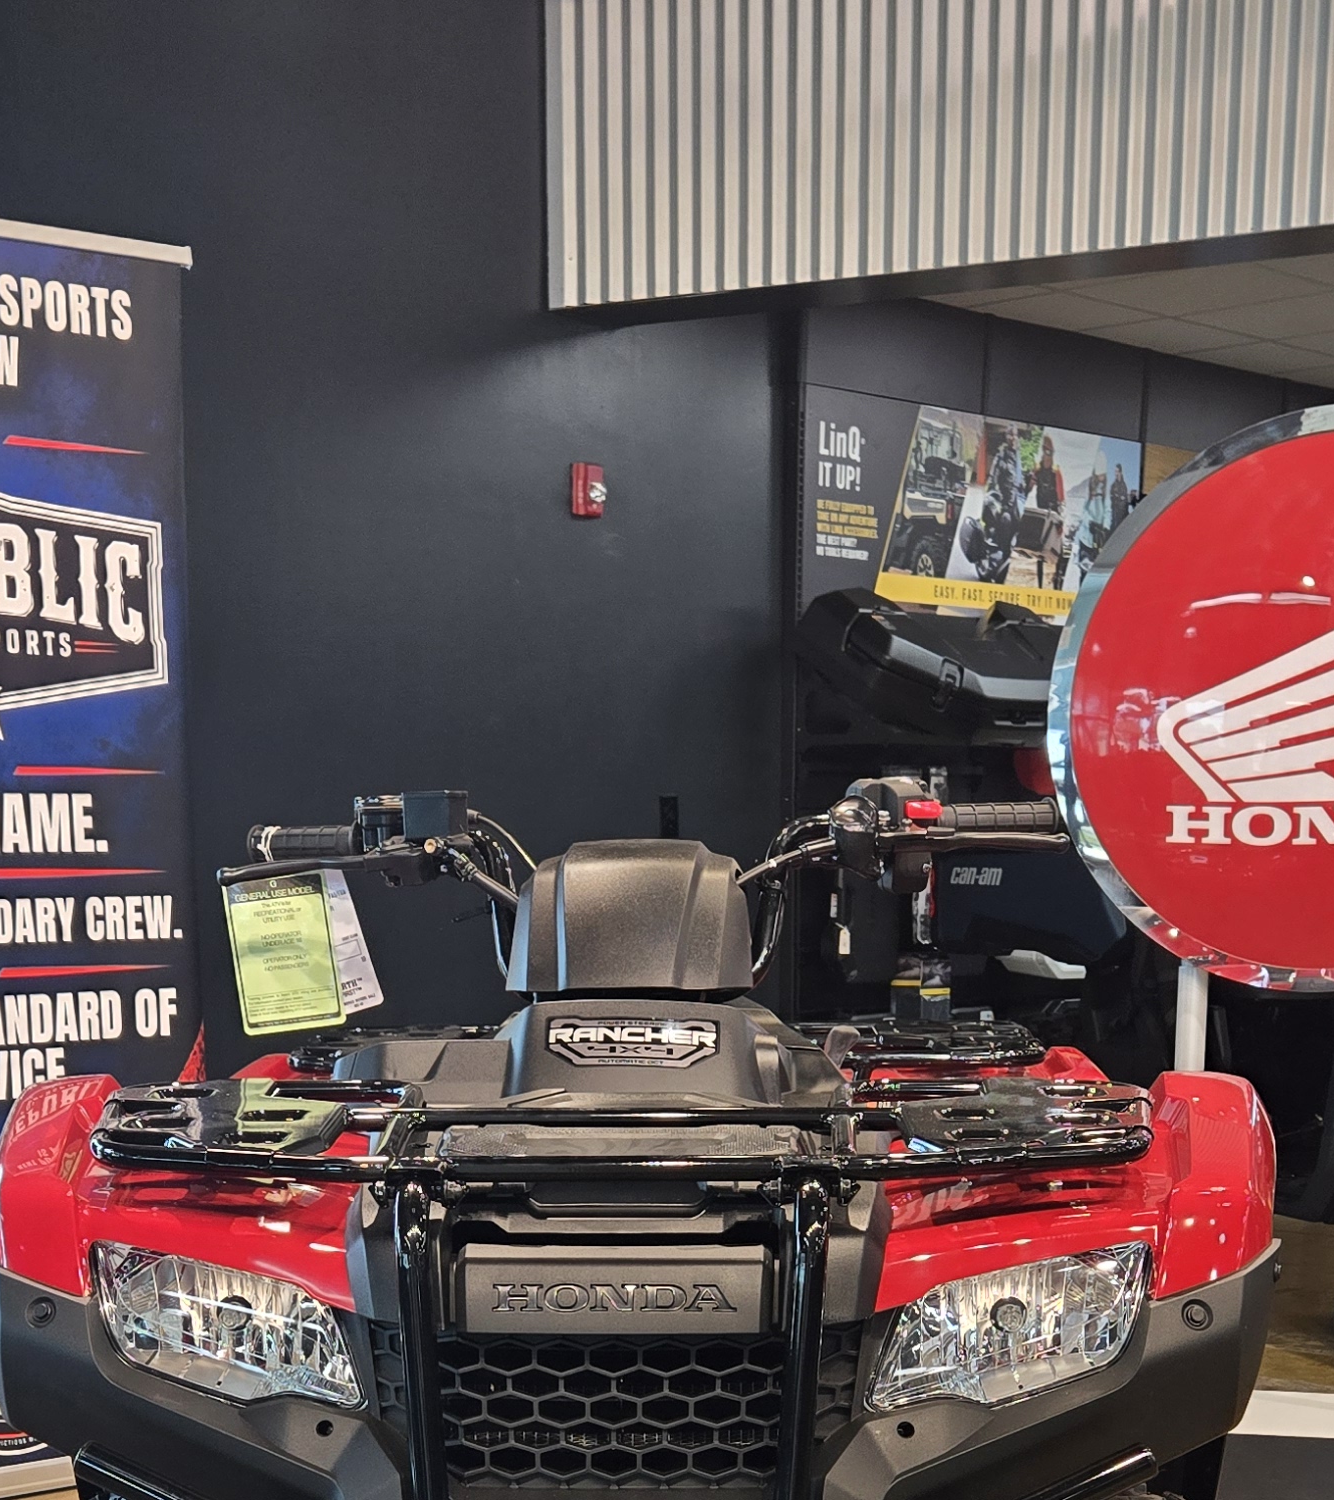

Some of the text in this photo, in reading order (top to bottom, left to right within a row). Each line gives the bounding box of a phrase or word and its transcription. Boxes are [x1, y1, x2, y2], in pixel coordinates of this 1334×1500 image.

[819, 421, 861, 463] LinQ
[818, 461, 861, 492] IT UP!
[933, 585, 958, 600] EASY.
[962, 587, 985, 602] FAST.
[1027, 594, 1042, 608] TRY
[1044, 596, 1053, 609] IT
[269, 880, 277, 888] G
[950, 866, 1003, 886] can-am
[234, 886, 315, 903] GENERAL USE MODEL
[85, 895, 183, 942] CREW.
[135, 987, 178, 1037] OF
[627, 1020, 677, 1029] STEERIN
[548, 1026, 717, 1048] RANCHER
[492, 1283, 738, 1313] HONDA
